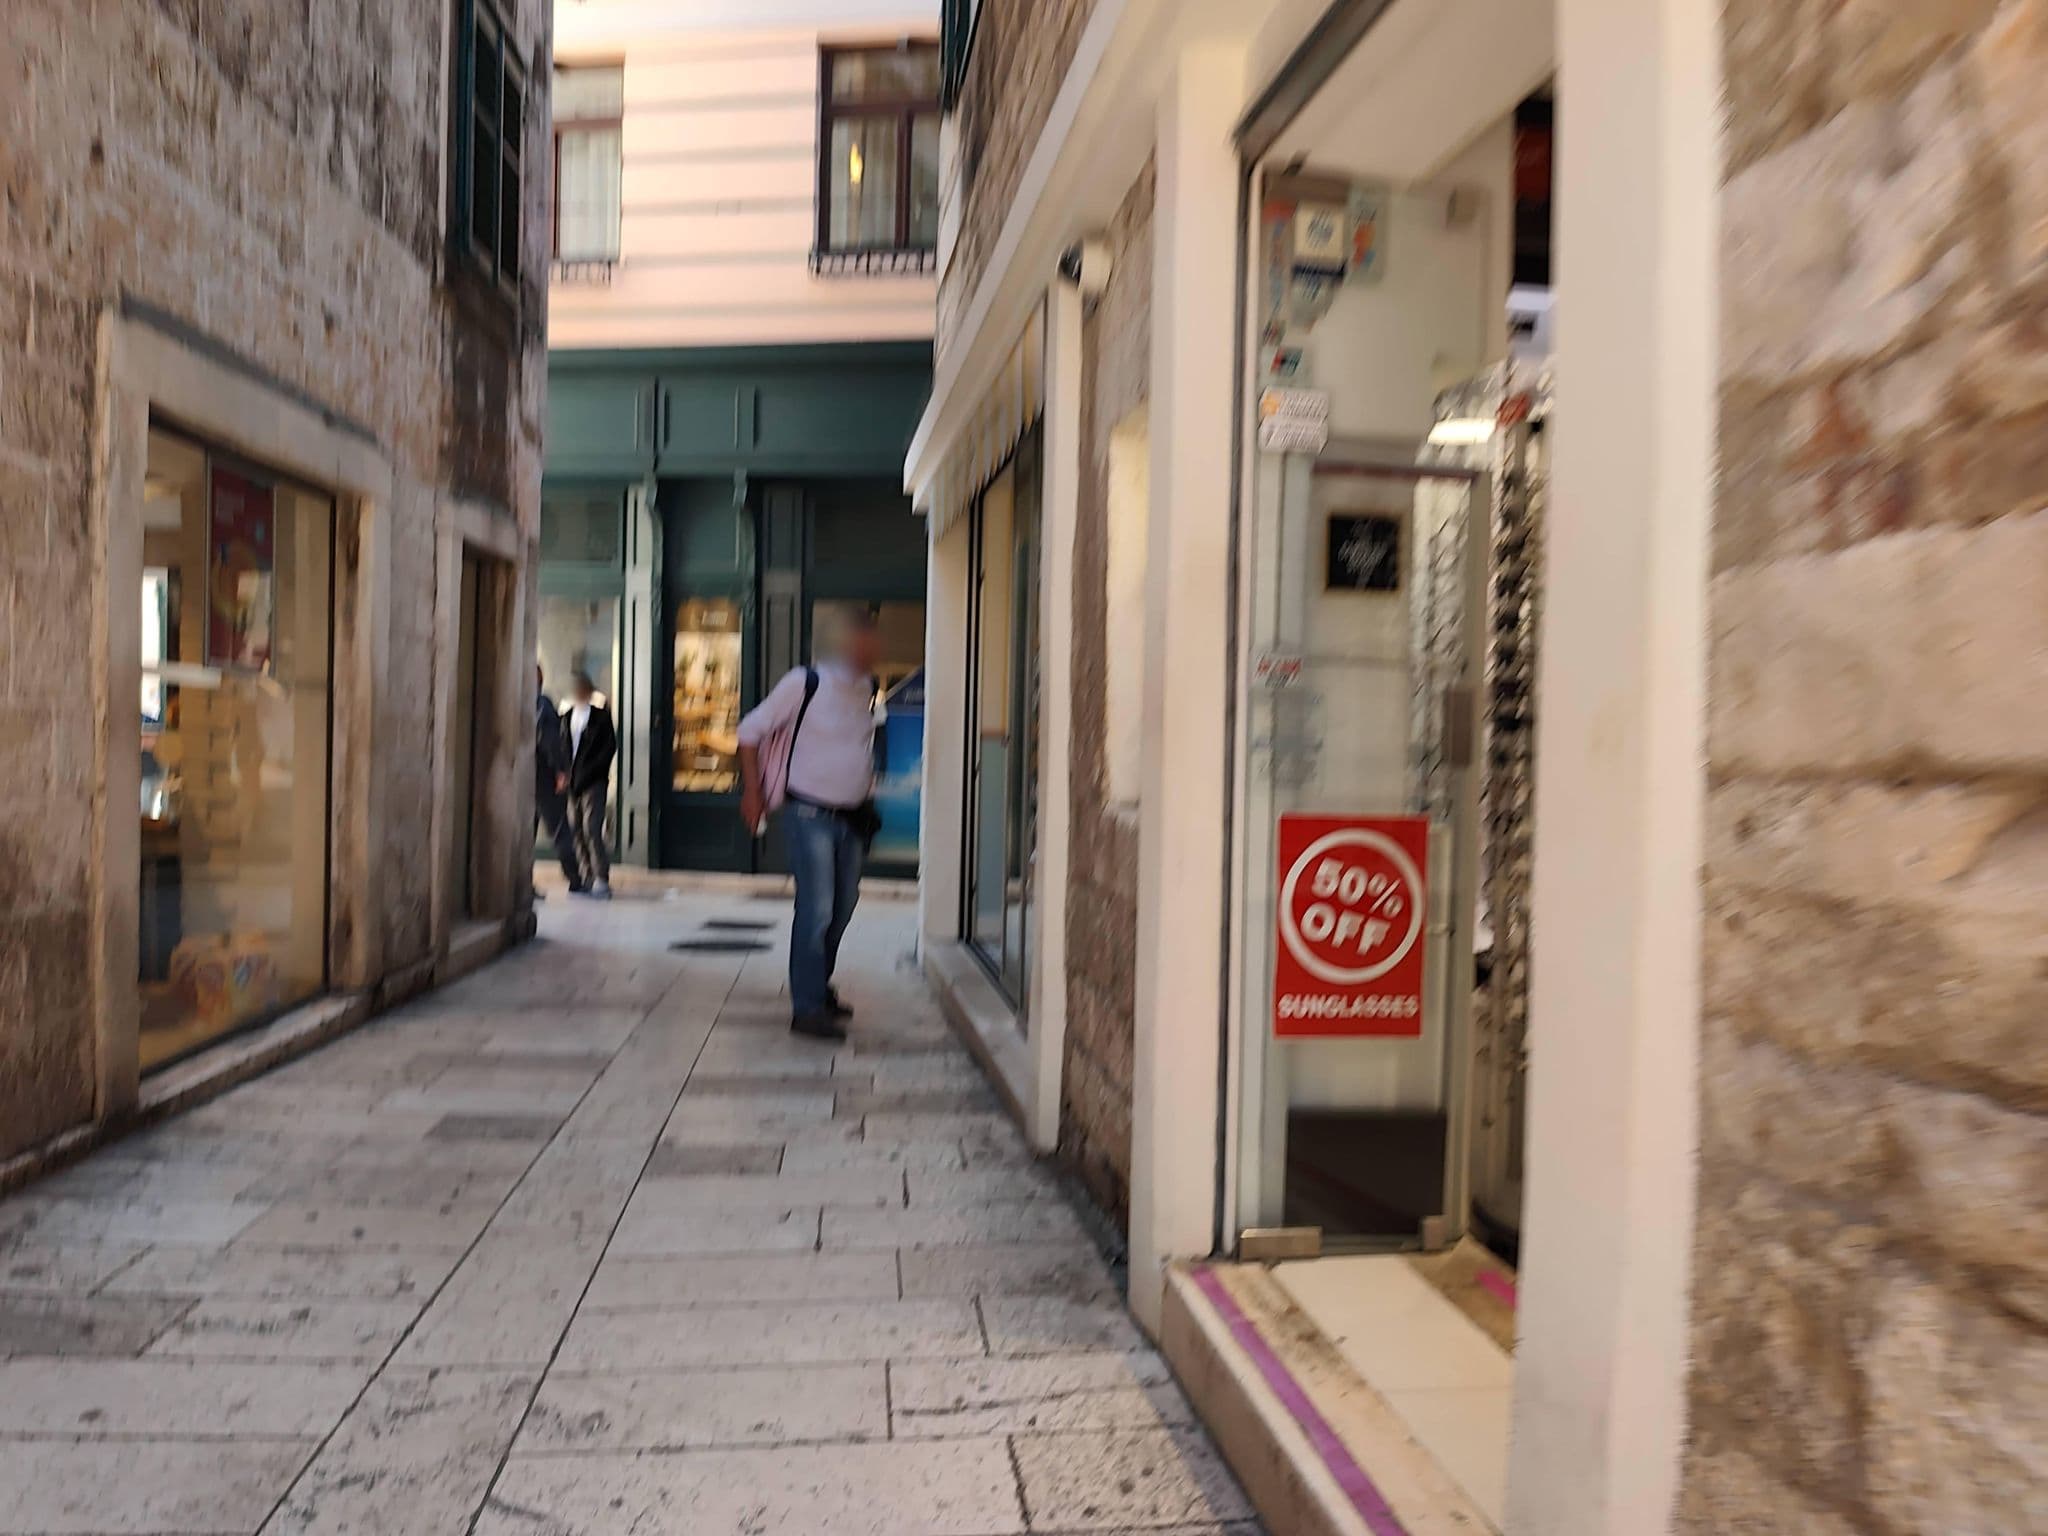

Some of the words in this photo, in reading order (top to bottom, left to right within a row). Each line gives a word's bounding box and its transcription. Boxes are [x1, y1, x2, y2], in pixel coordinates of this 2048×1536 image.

[1312, 858, 1403, 917] 50%
[1302, 903, 1390, 955] OFF
[1278, 994, 1418, 1018] SUNGLASSES
